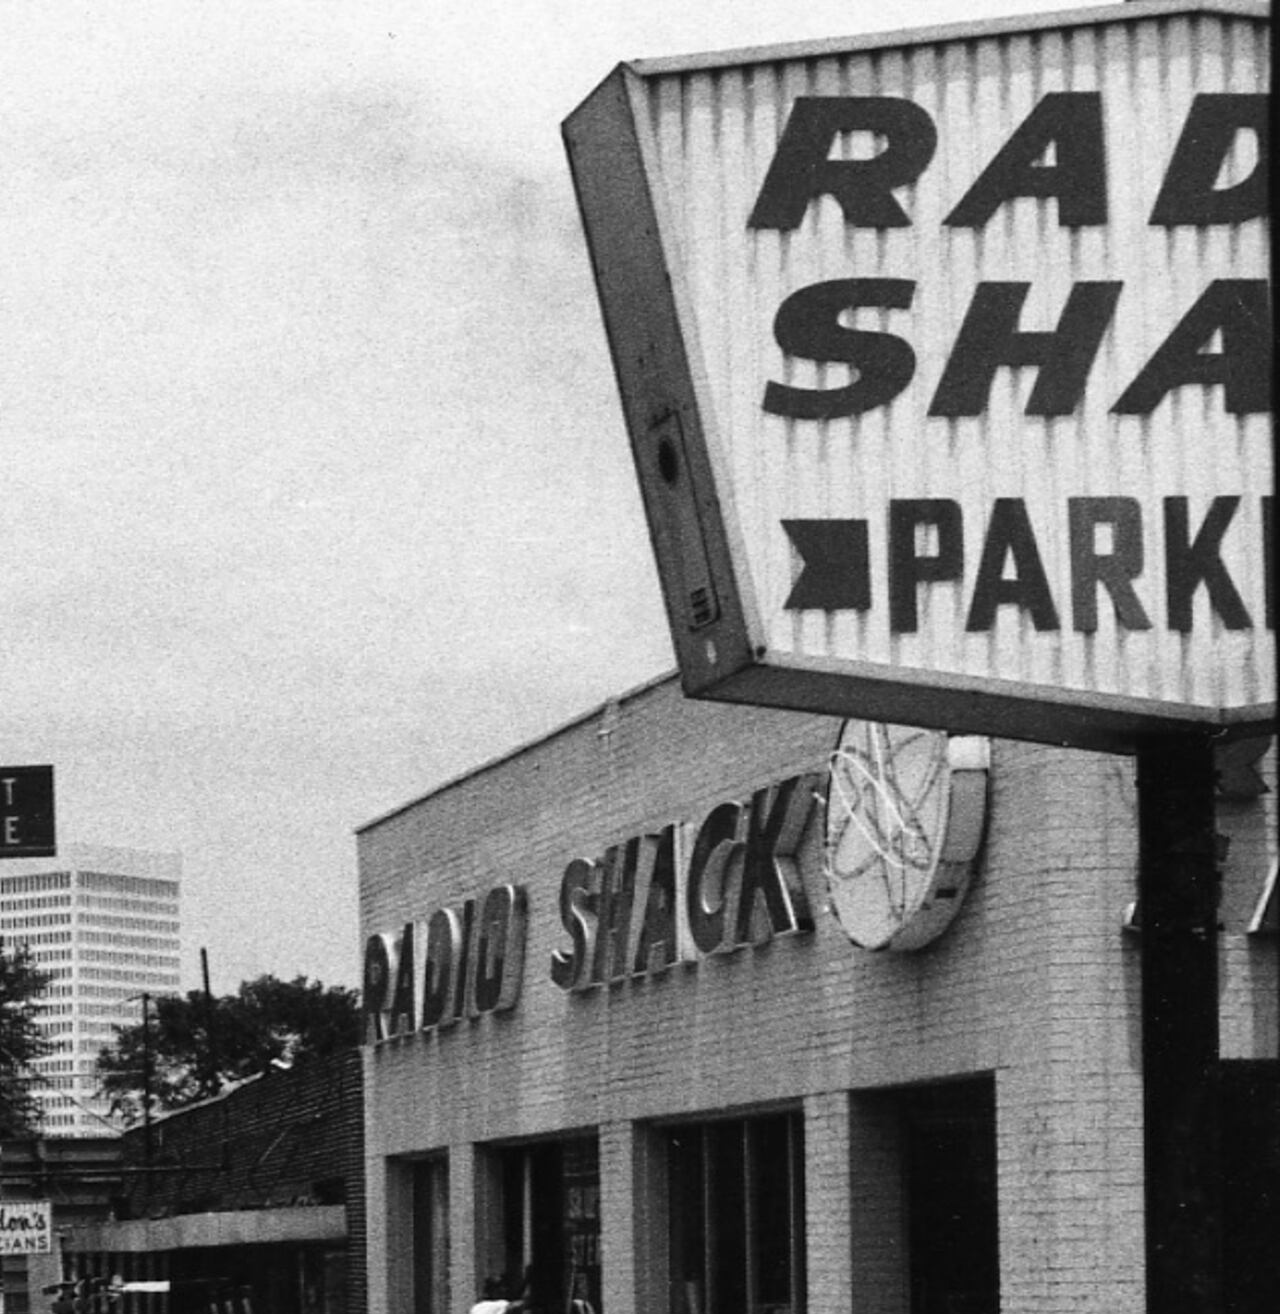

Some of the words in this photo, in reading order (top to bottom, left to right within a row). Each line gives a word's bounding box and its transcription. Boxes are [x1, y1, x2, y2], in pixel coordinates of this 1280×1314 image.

[746, 91, 1272, 231] RAD
[762, 277, 1272, 420] SHA
[887, 495, 1273, 634] PARK
[363, 884, 528, 1042] RADIO
[550, 773, 832, 993] SHACK
